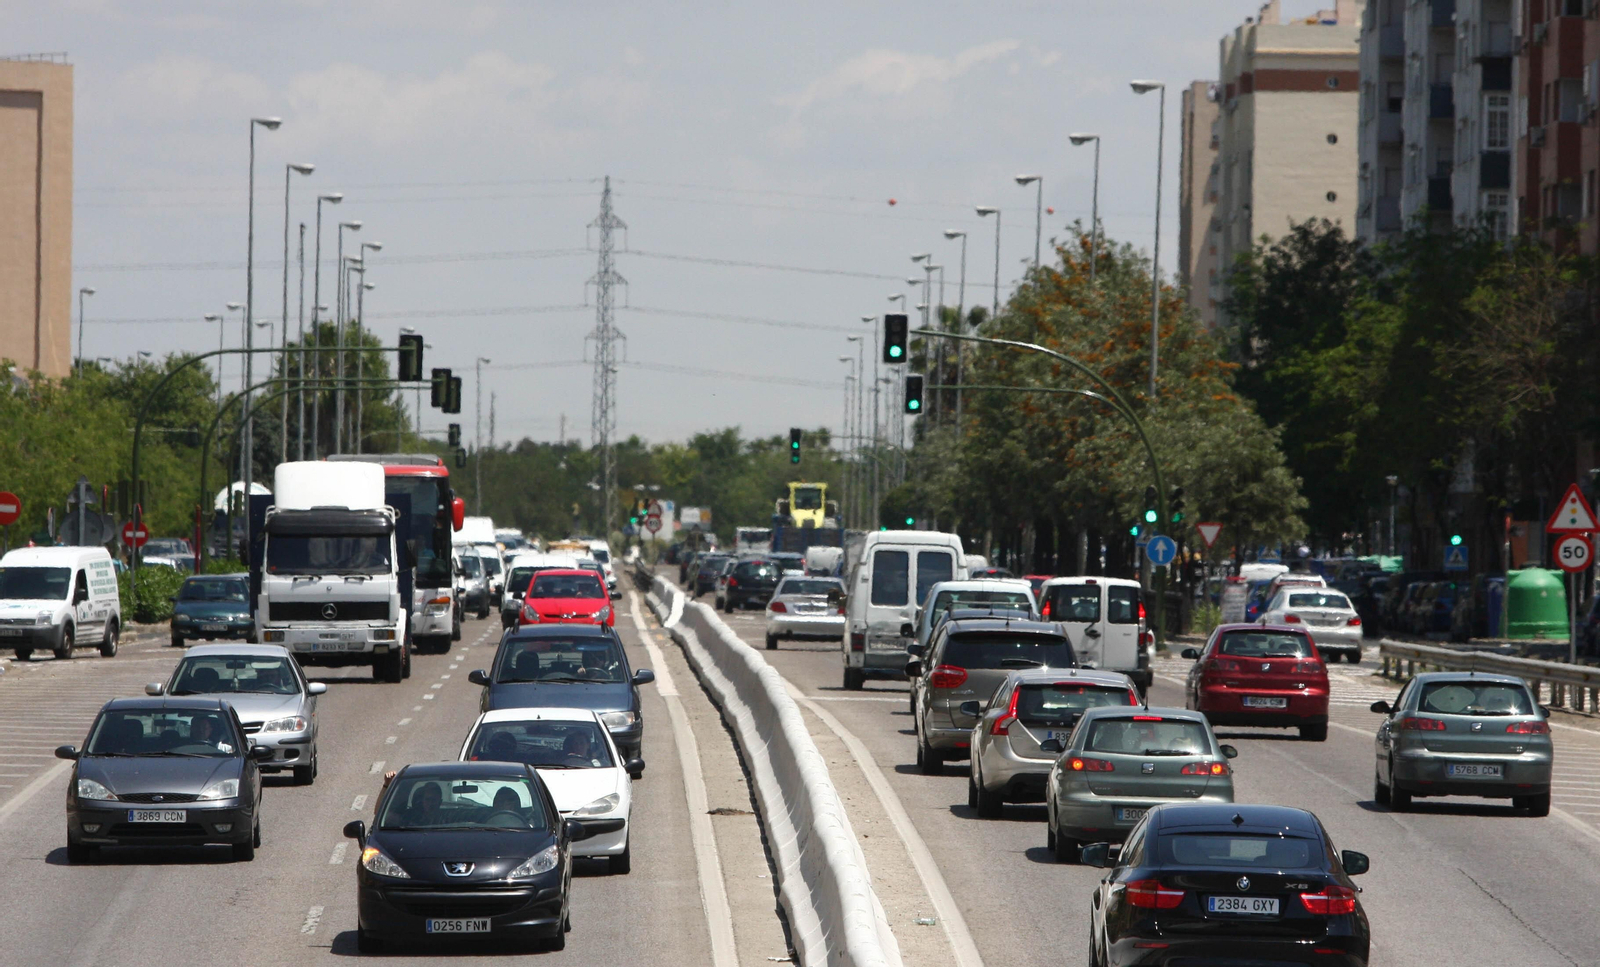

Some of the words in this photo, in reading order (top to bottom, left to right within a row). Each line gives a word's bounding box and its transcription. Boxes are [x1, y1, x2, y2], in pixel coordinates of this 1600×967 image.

[1563, 546, 1585, 559] 50
[1455, 765, 1478, 774] 5768
[137, 811, 160, 821] 3869
[164, 811, 183, 821] CCN
[1217, 899, 1247, 910] 2384
[1253, 899, 1275, 911] GXY
[433, 920, 462, 931] 0256
[466, 920, 488, 931] FNW
